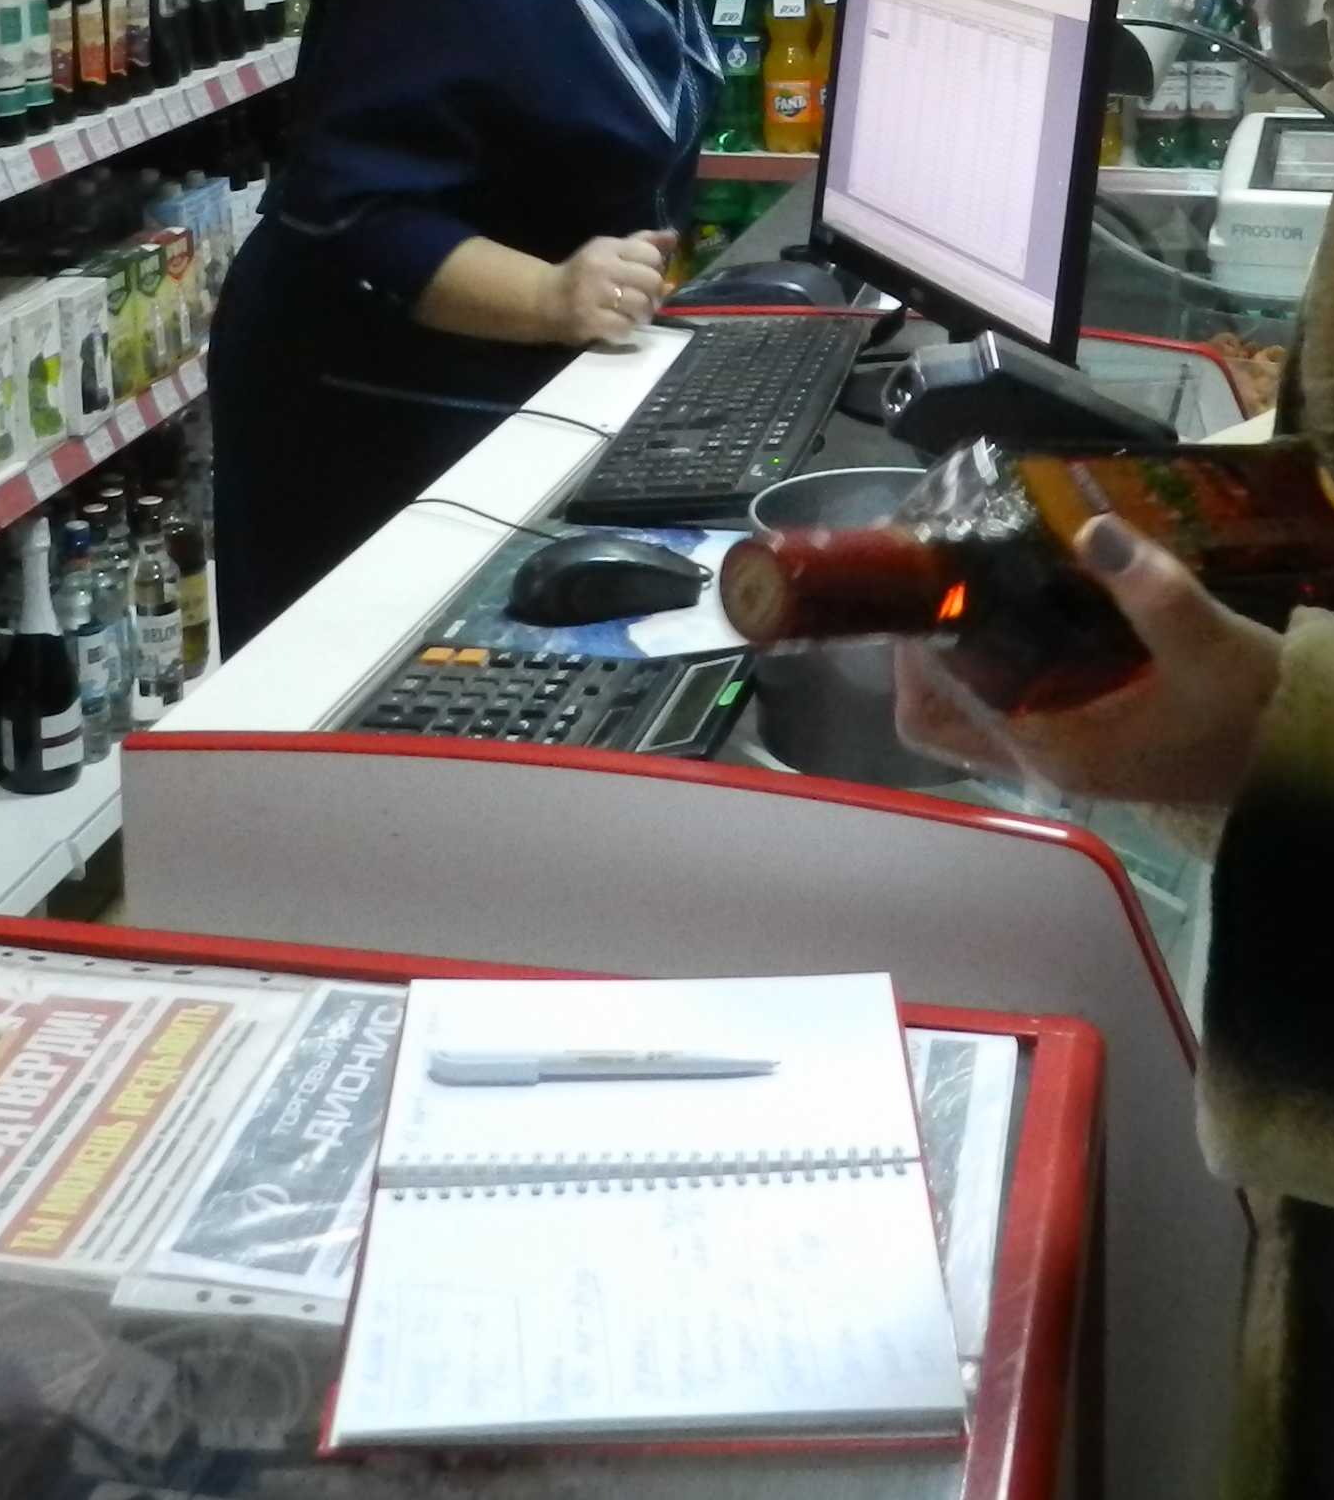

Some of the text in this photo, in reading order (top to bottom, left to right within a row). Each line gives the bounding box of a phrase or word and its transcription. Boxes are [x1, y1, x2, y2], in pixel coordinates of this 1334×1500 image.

[1230, 222, 1304, 241] FROSTOR
[107, 1004, 219, 1117] ПРЕДЪЯВИТЬ
[270, 1035, 342, 1136] ТОРГОВЫЙ
[302, 1004, 404, 1148] ДИОНИС
[36, 1120, 138, 1215] МОЖЕШЬ
[9, 1216, 71, 1249] ТЫ
